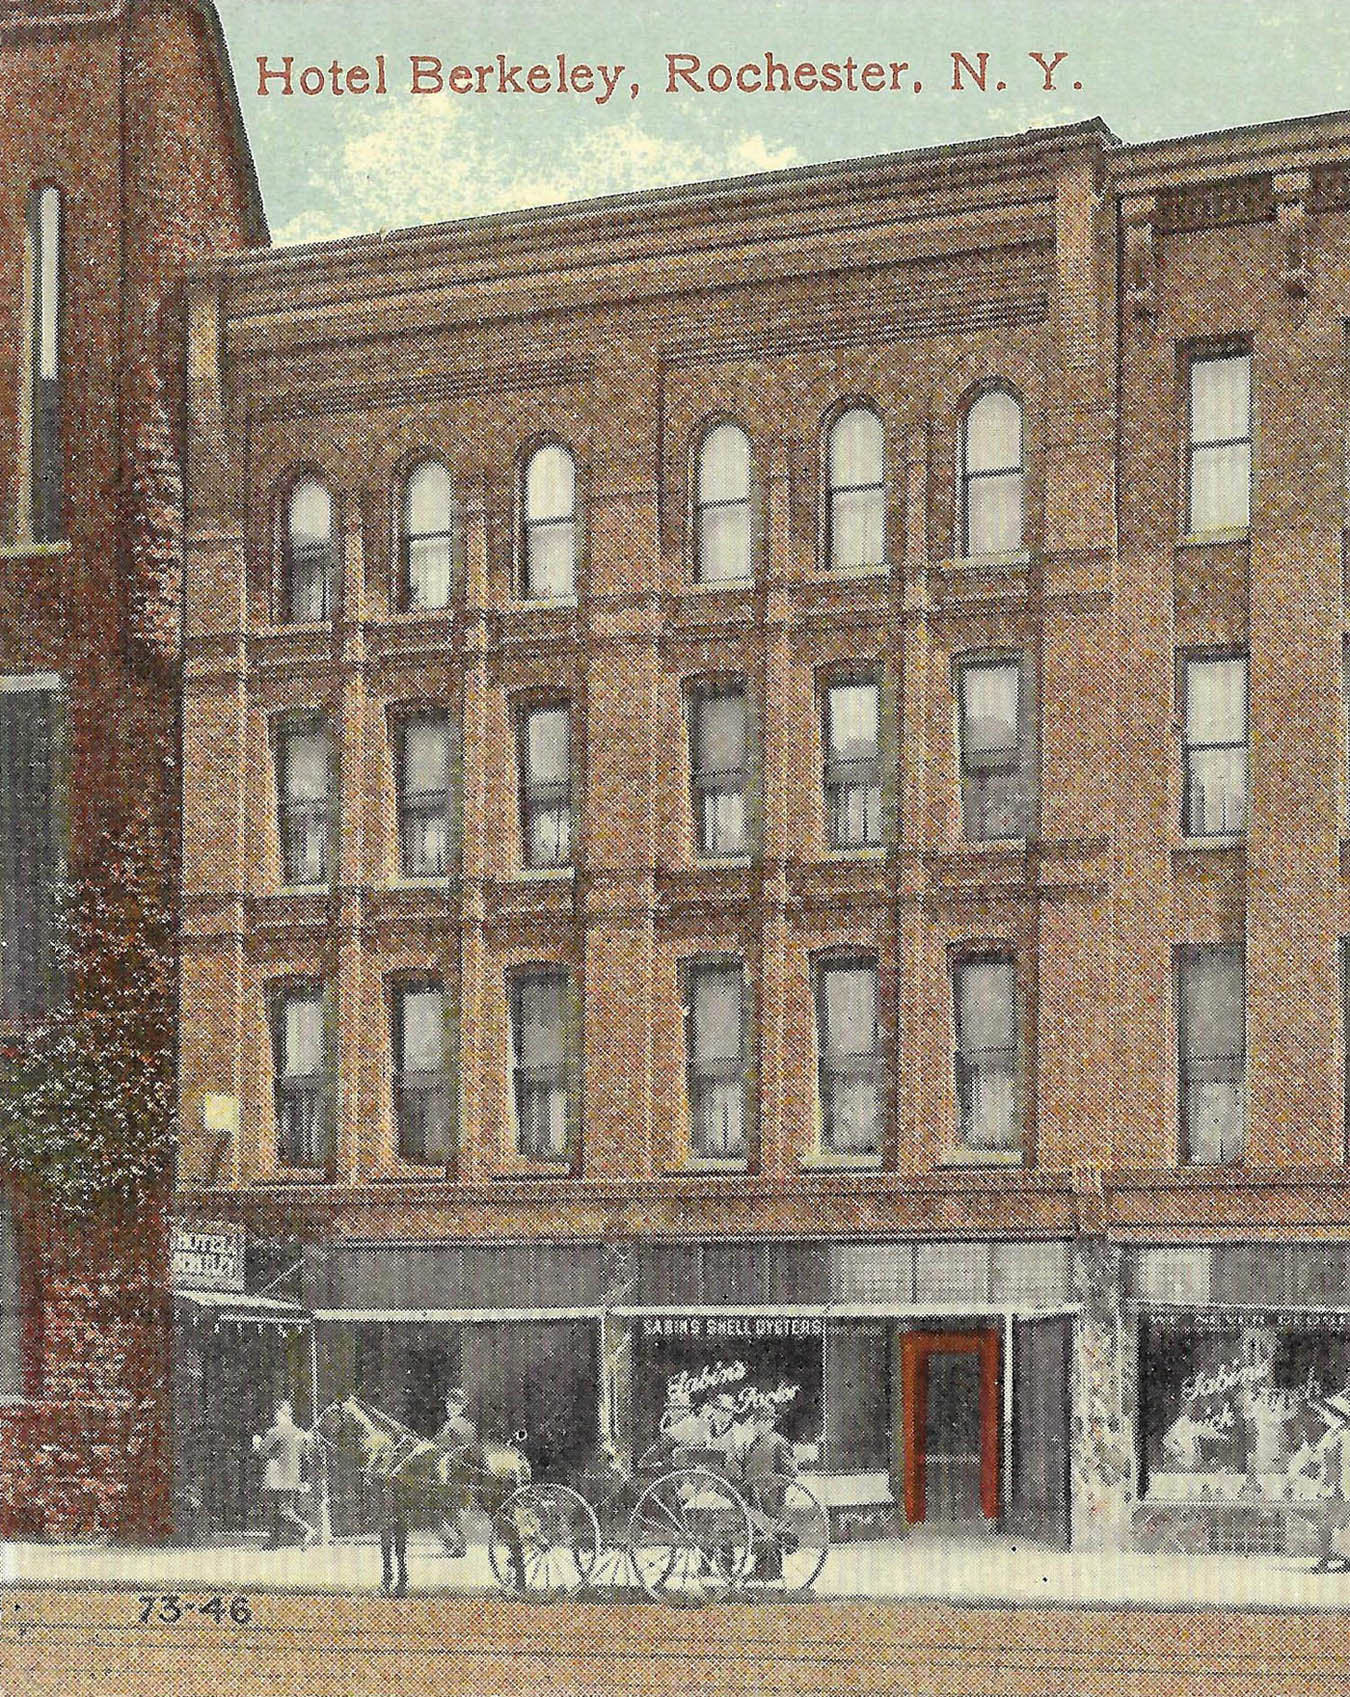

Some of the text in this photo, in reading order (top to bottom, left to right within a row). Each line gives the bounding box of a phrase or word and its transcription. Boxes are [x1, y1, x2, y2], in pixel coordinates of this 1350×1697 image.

[1194, 1314, 1266, 1326] NEVER
[706, 1319, 752, 1336] SHELL
[755, 1319, 823, 1336] OYSTERS
